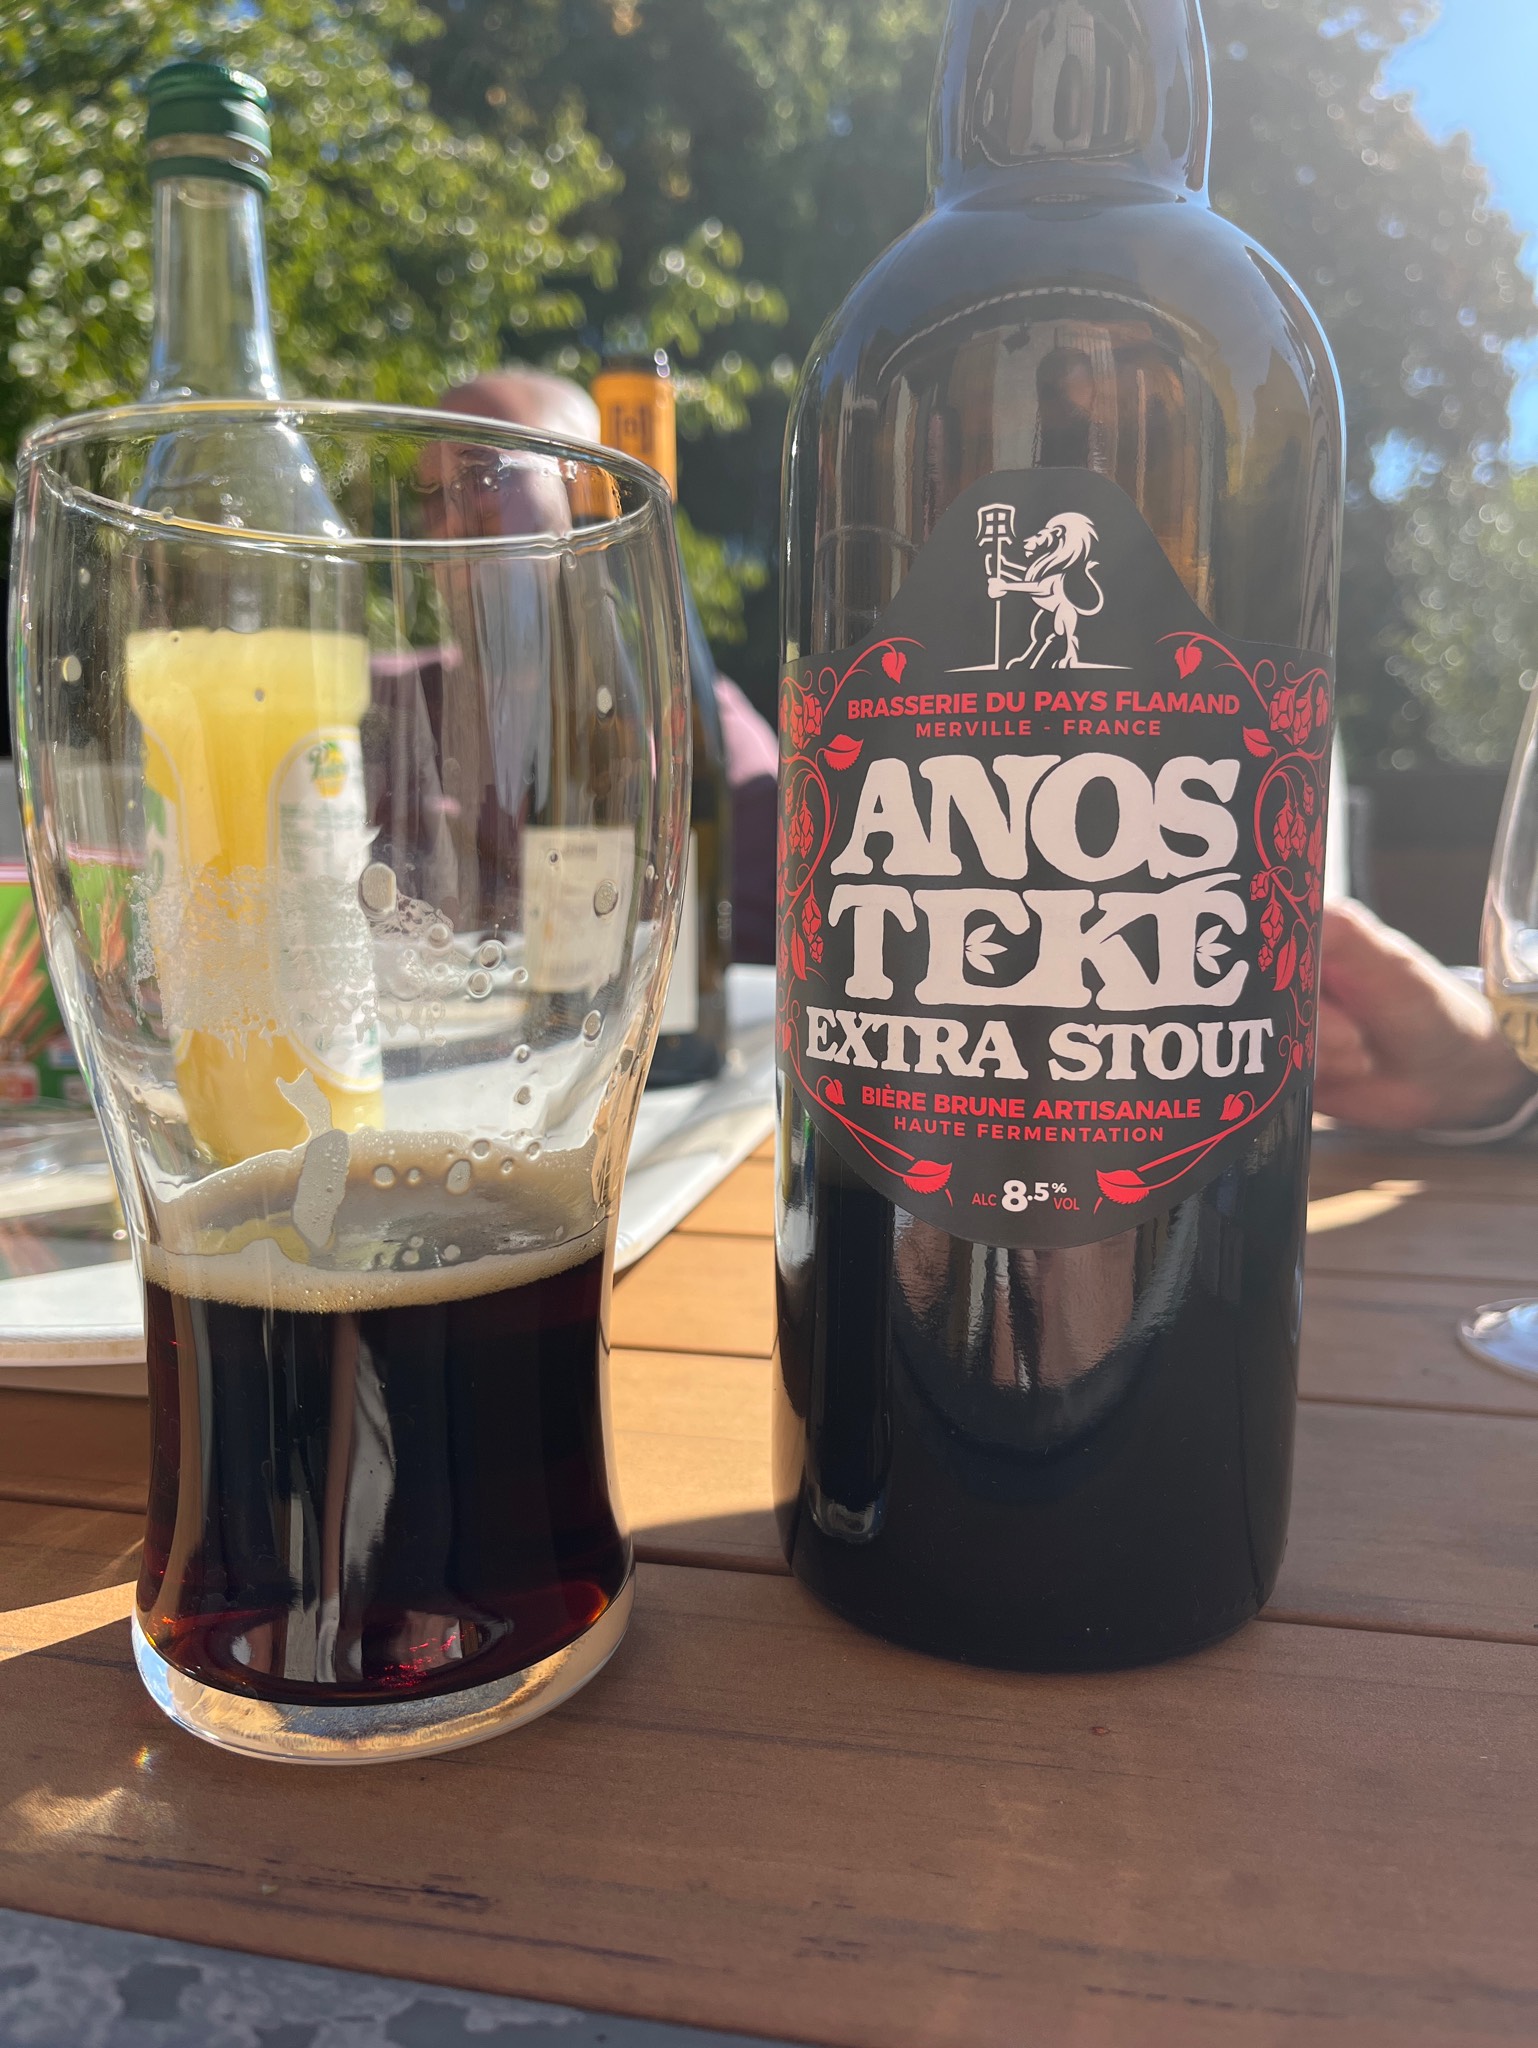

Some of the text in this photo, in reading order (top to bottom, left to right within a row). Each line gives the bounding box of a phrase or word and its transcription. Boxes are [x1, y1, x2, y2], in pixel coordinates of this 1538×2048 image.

[848, 691, 1241, 720] BRASSERIE DU PAYS FLAMAND
[915, 720, 1032, 738] MERVILLE
[1063, 719, 1161, 736] FRANCE
[830, 752, 1241, 881] ANOS
[828, 872, 1250, 1012] TEKÉ
[805, 1005, 1274, 1081] EXTRA STOUT
[862, 1084, 1202, 1121] BIÈRE BRUNE ARTISANALE
[894, 1115, 1165, 1143] HAUTE FERMENTATION
[971, 1192, 997, 1207] ALC
[1053, 1197, 1080, 1211] VOL
